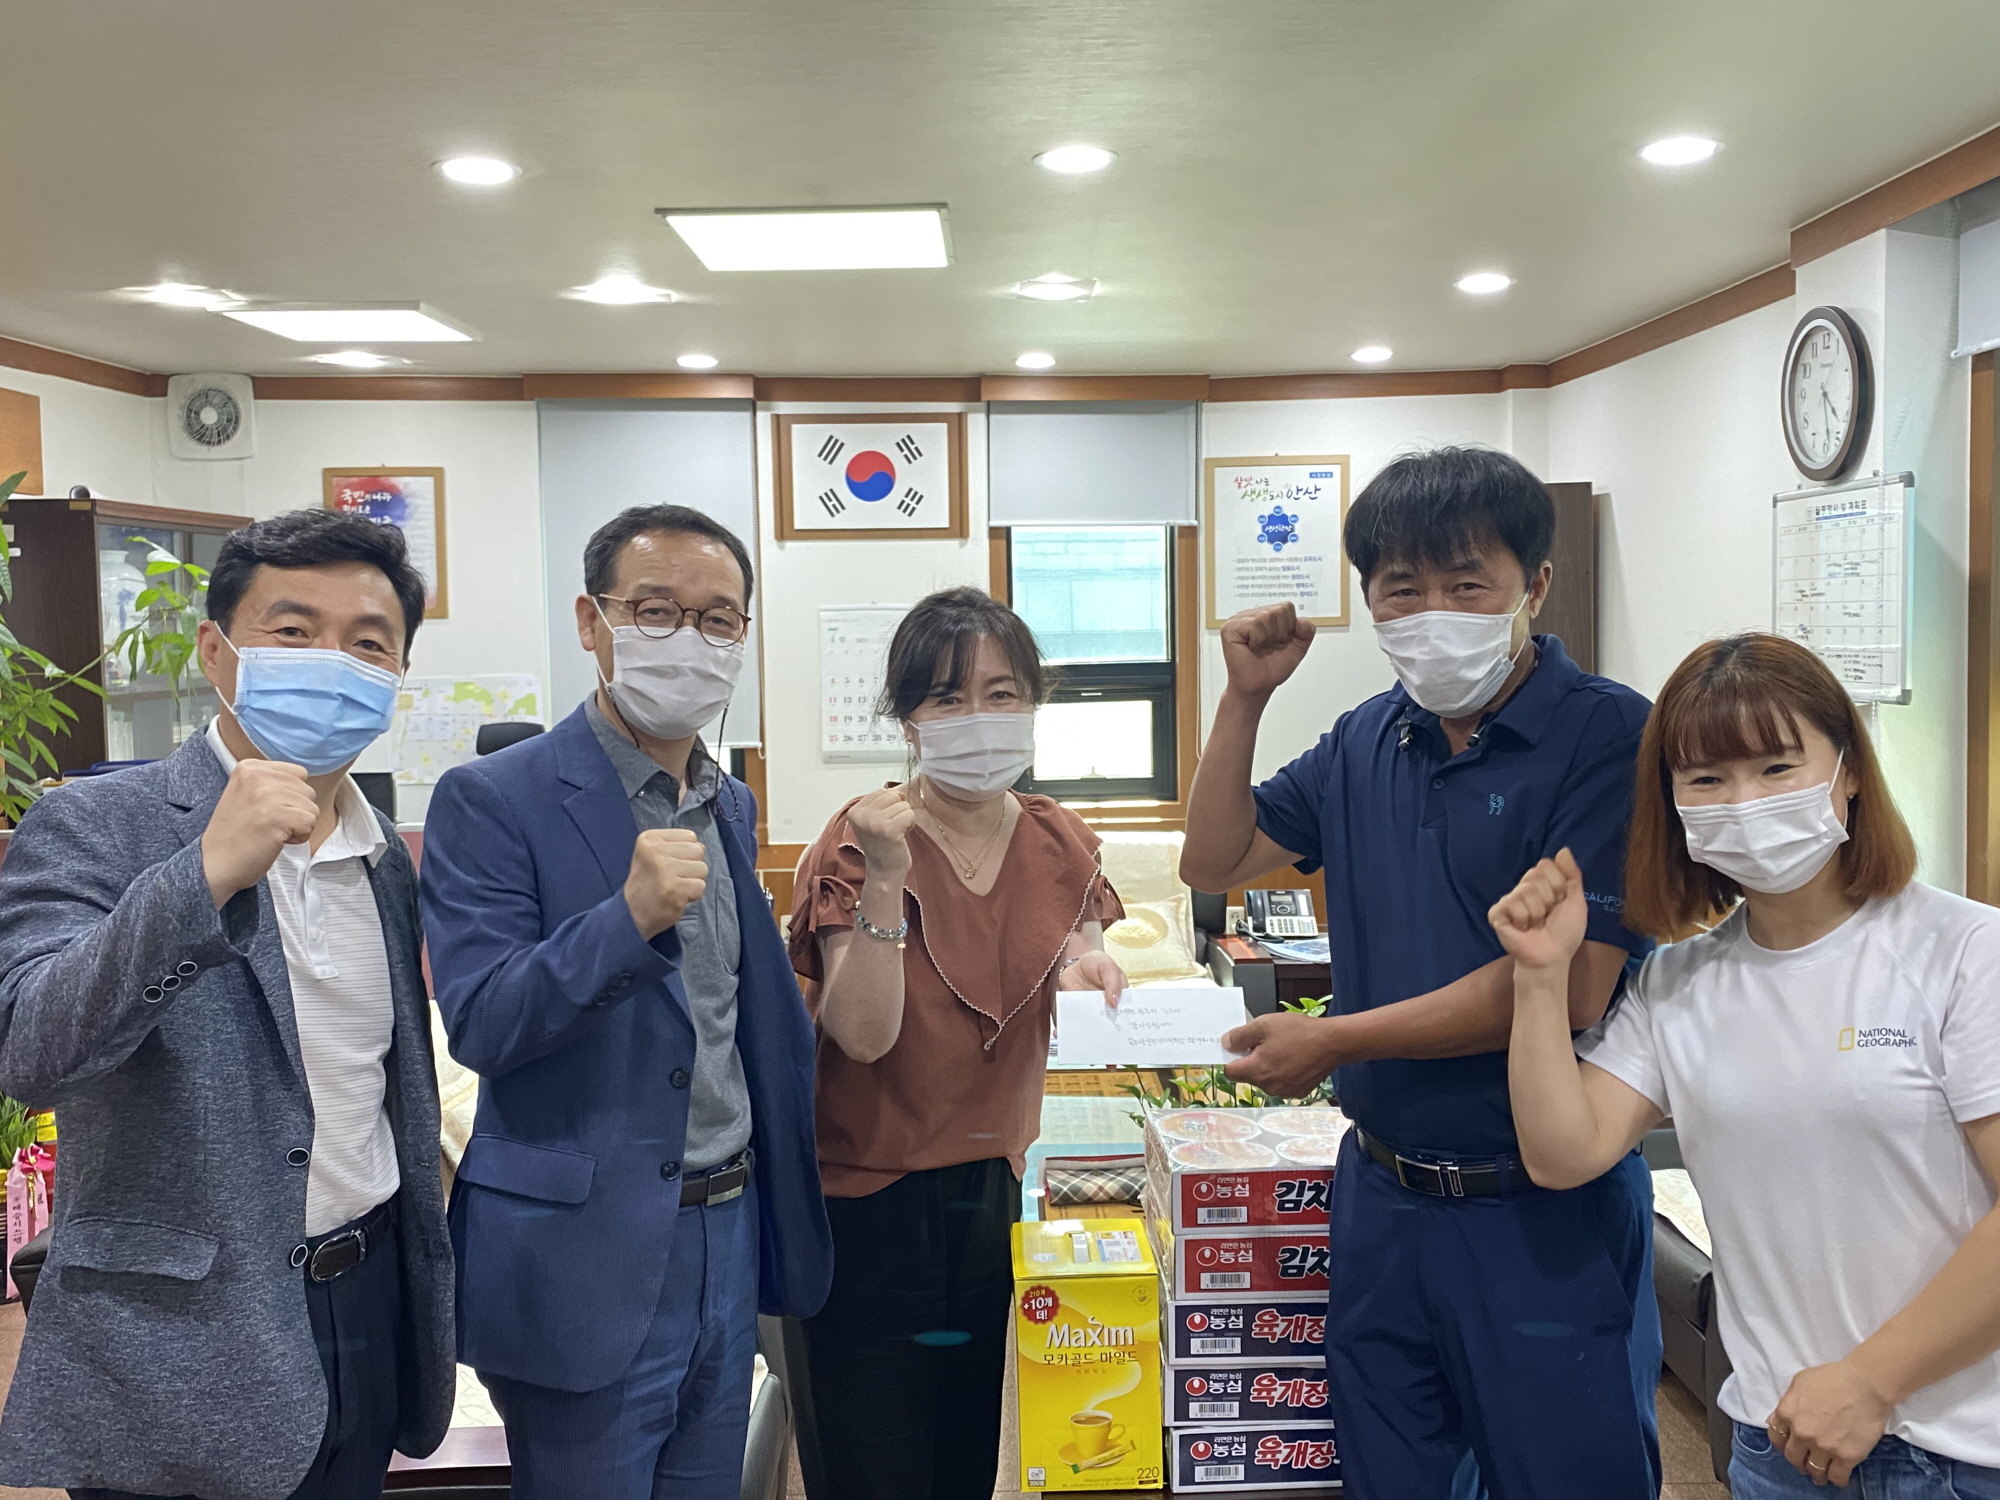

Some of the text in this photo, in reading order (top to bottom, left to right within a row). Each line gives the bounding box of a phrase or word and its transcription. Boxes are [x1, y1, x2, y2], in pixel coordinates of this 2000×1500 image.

[1823, 333, 1830, 350] 12
[1812, 342, 1818, 358] 11
[1801, 362, 1812, 379] 10
[1800, 388, 1806, 402] 9
[1803, 412, 1808, 429] 8
[1823, 440, 1828, 454] 6
[1256, 478, 1270, 486] 나는
[372, 492, 392, 502] 나라
[1286, 484, 1322, 500] 안산
[856, 734, 868, 742] 27
[1858, 1028, 1908, 1038] NATIONAL
[1216, 1184, 1250, 1198] 농심
[1220, 1250, 1253, 1264] 농심
[1029, 1290, 1046, 1298] 210개
[1024, 1296, 1053, 1310] +10개
[1036, 1310, 1048, 1320] 더!
[1210, 1315, 1244, 1330] 농심
[1046, 1317, 1135, 1348] Maxim
[1044, 1351, 1139, 1366] 모카골드 마일드
[1208, 1373, 1329, 1408] 농심 육개장
[1213, 1435, 1336, 1470] 농심 육개장
[1136, 1466, 1160, 1480] 220
